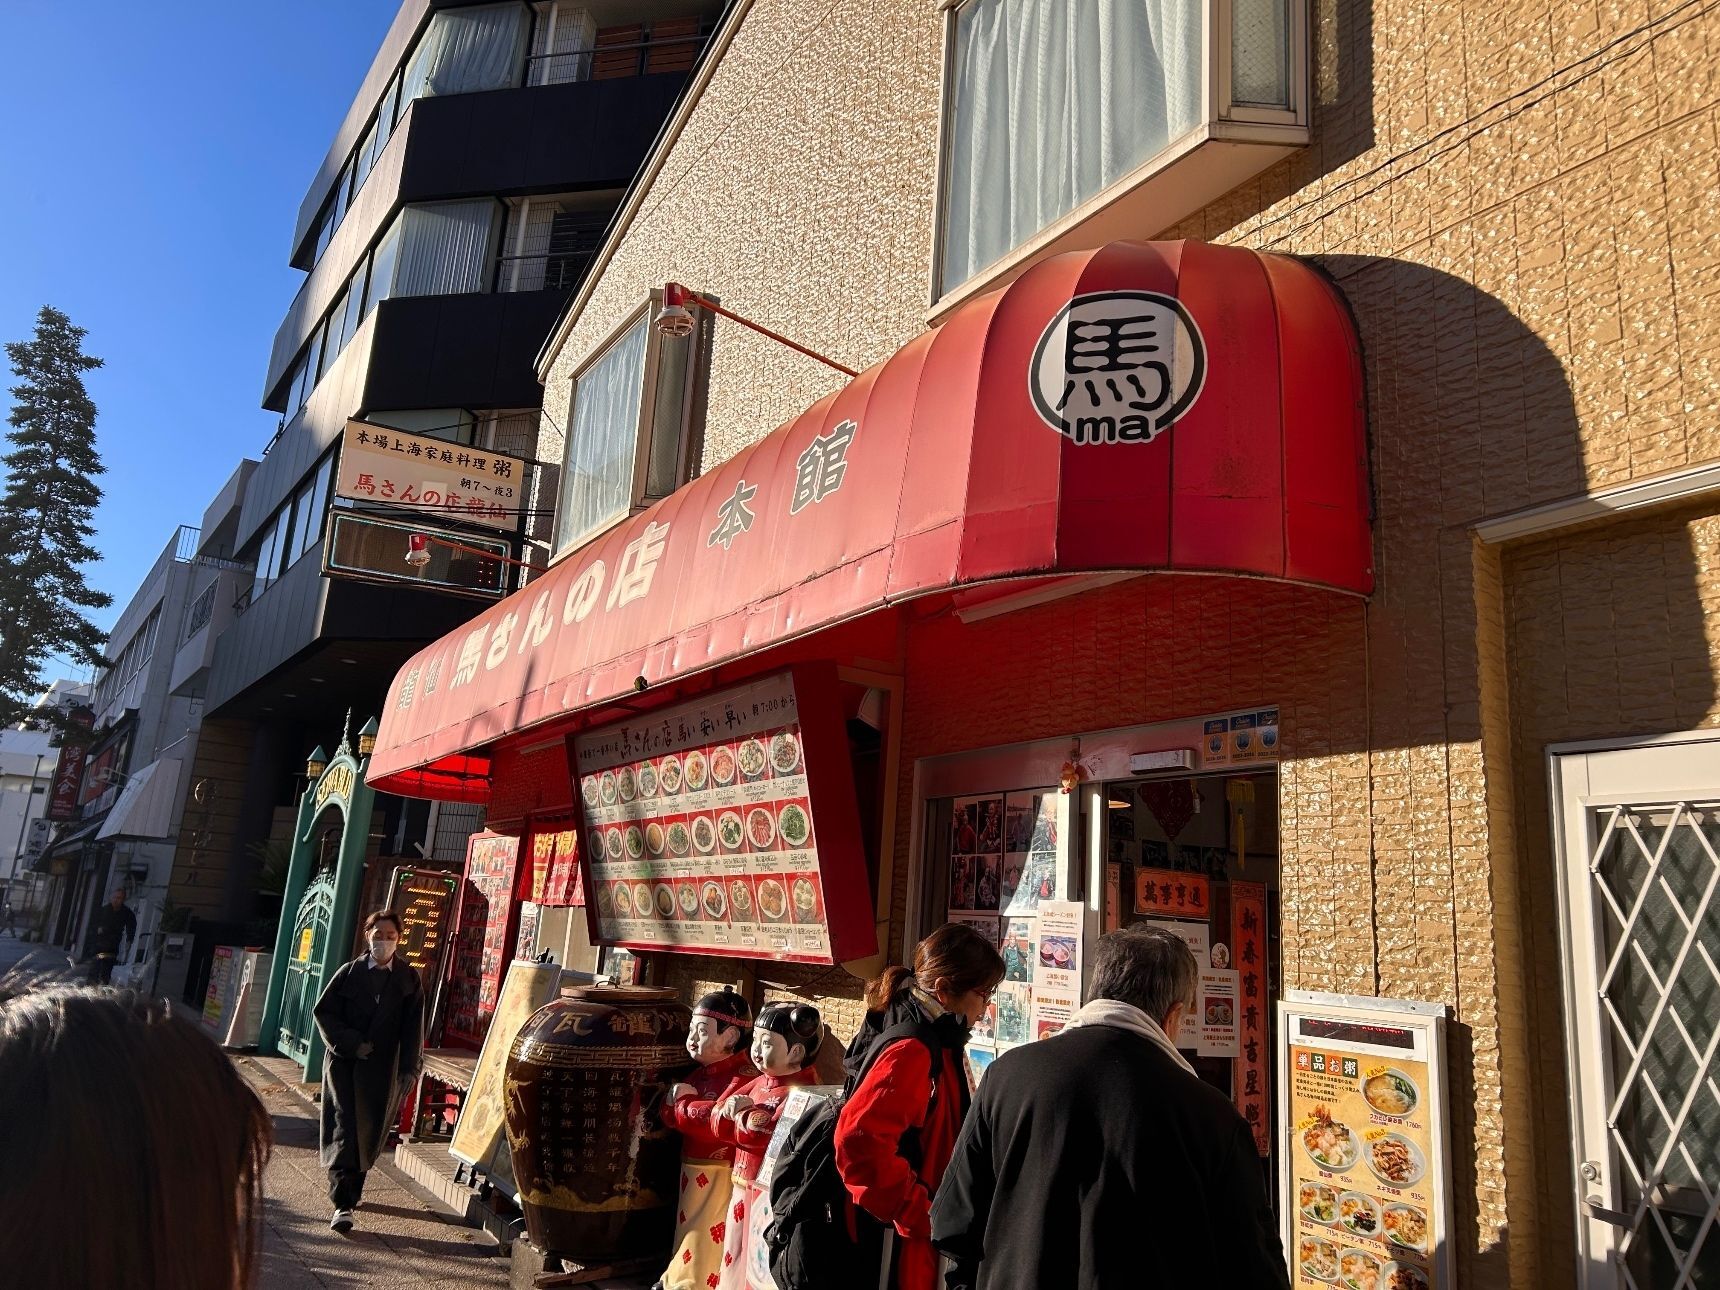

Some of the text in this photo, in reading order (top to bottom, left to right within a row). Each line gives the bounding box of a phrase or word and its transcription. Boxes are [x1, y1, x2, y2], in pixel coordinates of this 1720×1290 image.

[1055, 315, 1171, 411] 馬
[1075, 415, 1151, 442] ma
[356, 429, 512, 479] 本場上海家庭料理 粥
[354, 473, 507, 521] 馬さんの店龍仙
[449, 520, 671, 691] 馬さんの店
[707, 419, 858, 551] 本館
[1297, 1053, 1356, 1076] 単品お粥
